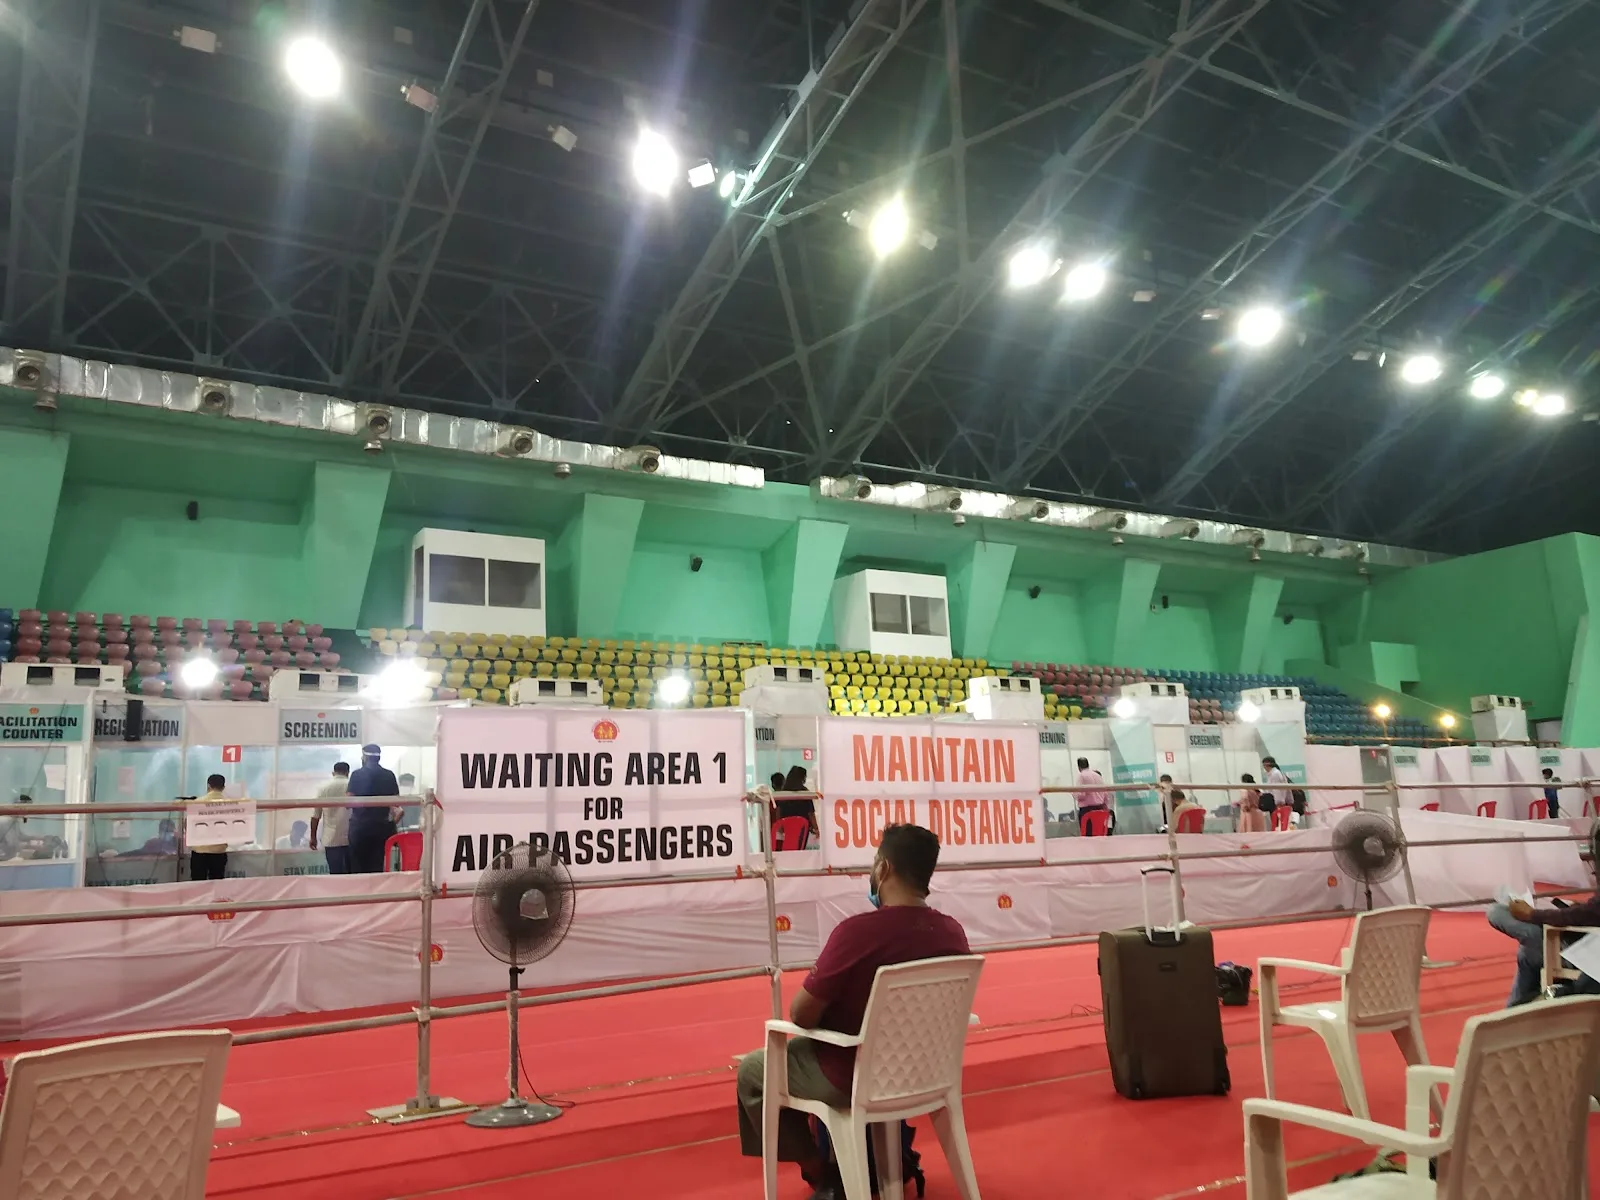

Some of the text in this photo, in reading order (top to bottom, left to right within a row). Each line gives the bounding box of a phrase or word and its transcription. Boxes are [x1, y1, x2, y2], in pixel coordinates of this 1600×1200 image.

[0, 716, 78, 727] ACILITATION
[95, 719, 179, 737] REGISATION
[284, 722, 357, 738] SCREENING
[3, 728, 64, 739] COUNTER
[1189, 735, 1222, 746] SCREENING
[226, 747, 236, 761] 1
[853, 734, 1015, 783] MAINTAIN
[460, 752, 727, 789] WAITING AREA 1
[584, 797, 623, 821] FOR
[928, 799, 1035, 846] DISTANCE
[451, 824, 733, 872] AIR PASSENGERS
